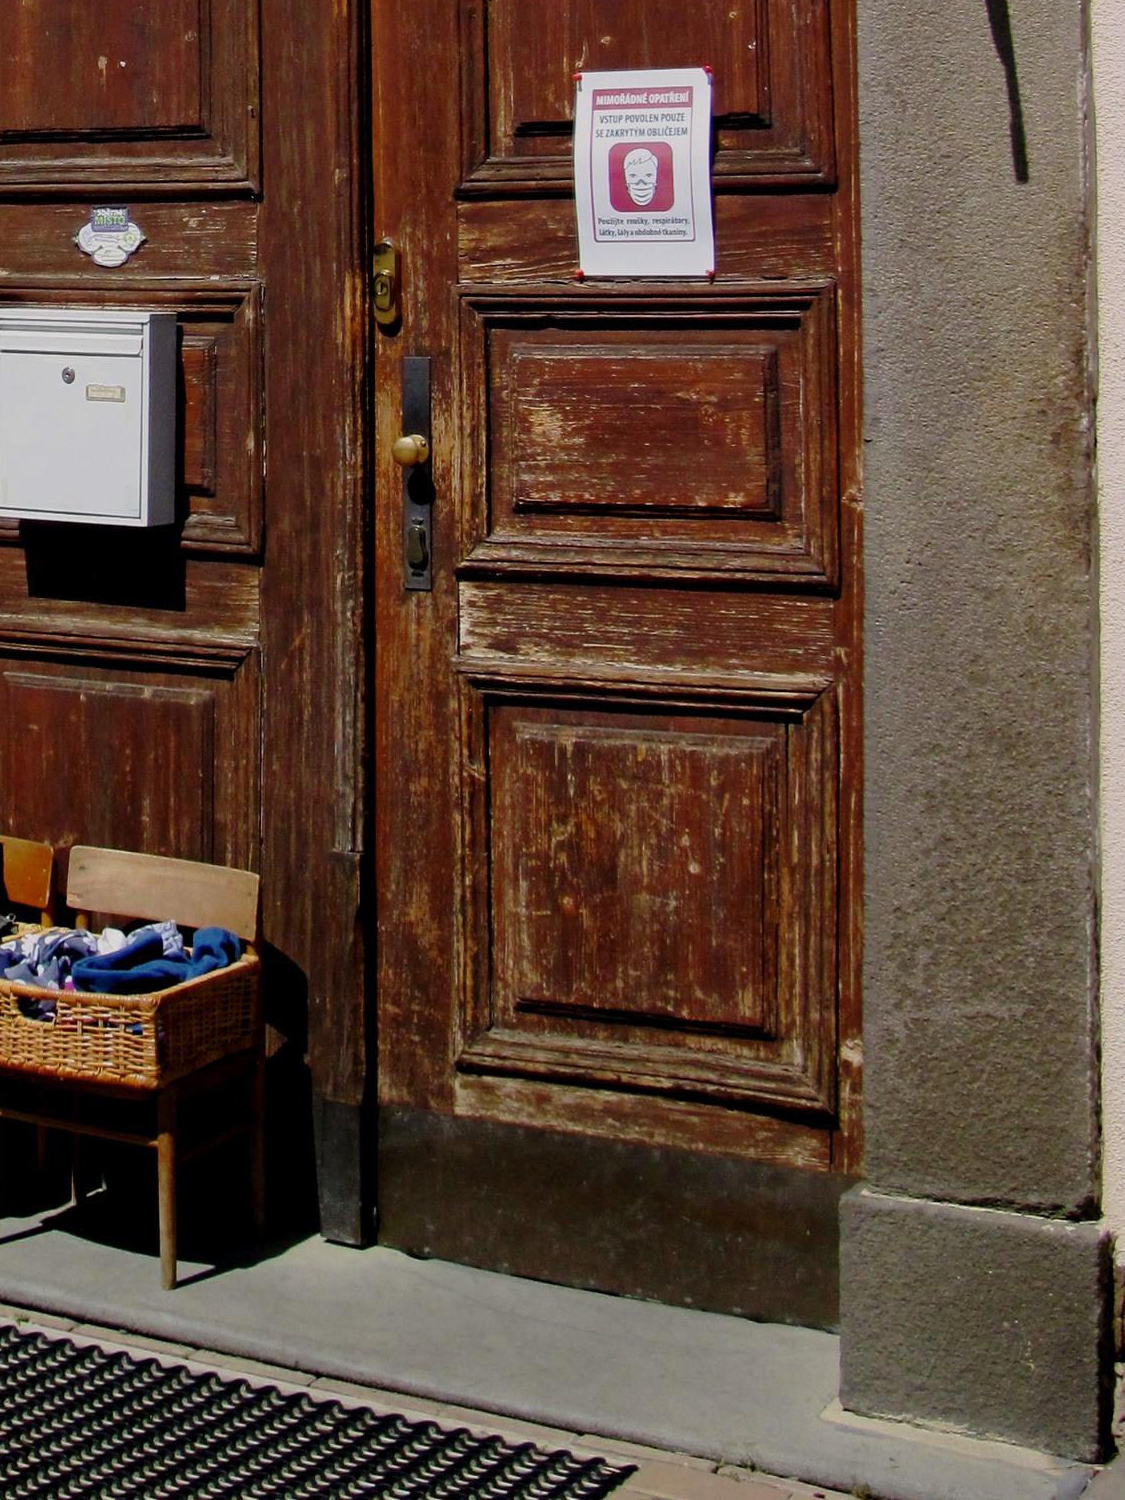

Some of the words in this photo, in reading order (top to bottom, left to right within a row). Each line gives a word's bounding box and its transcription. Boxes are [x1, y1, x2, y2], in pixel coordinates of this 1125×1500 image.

[596, 92, 648, 106] MIMOŘÁDNÉ
[648, 91, 690, 104] OPATŘENÍ
[599, 114, 624, 124] VSTUP
[625, 113, 659, 123] POVOLEN
[661, 112, 686, 122] POUZE
[595, 129, 604, 138] SE
[605, 126, 646, 138] ZAKRYTÝM
[646, 126, 688, 137] OBLIČEJEM
